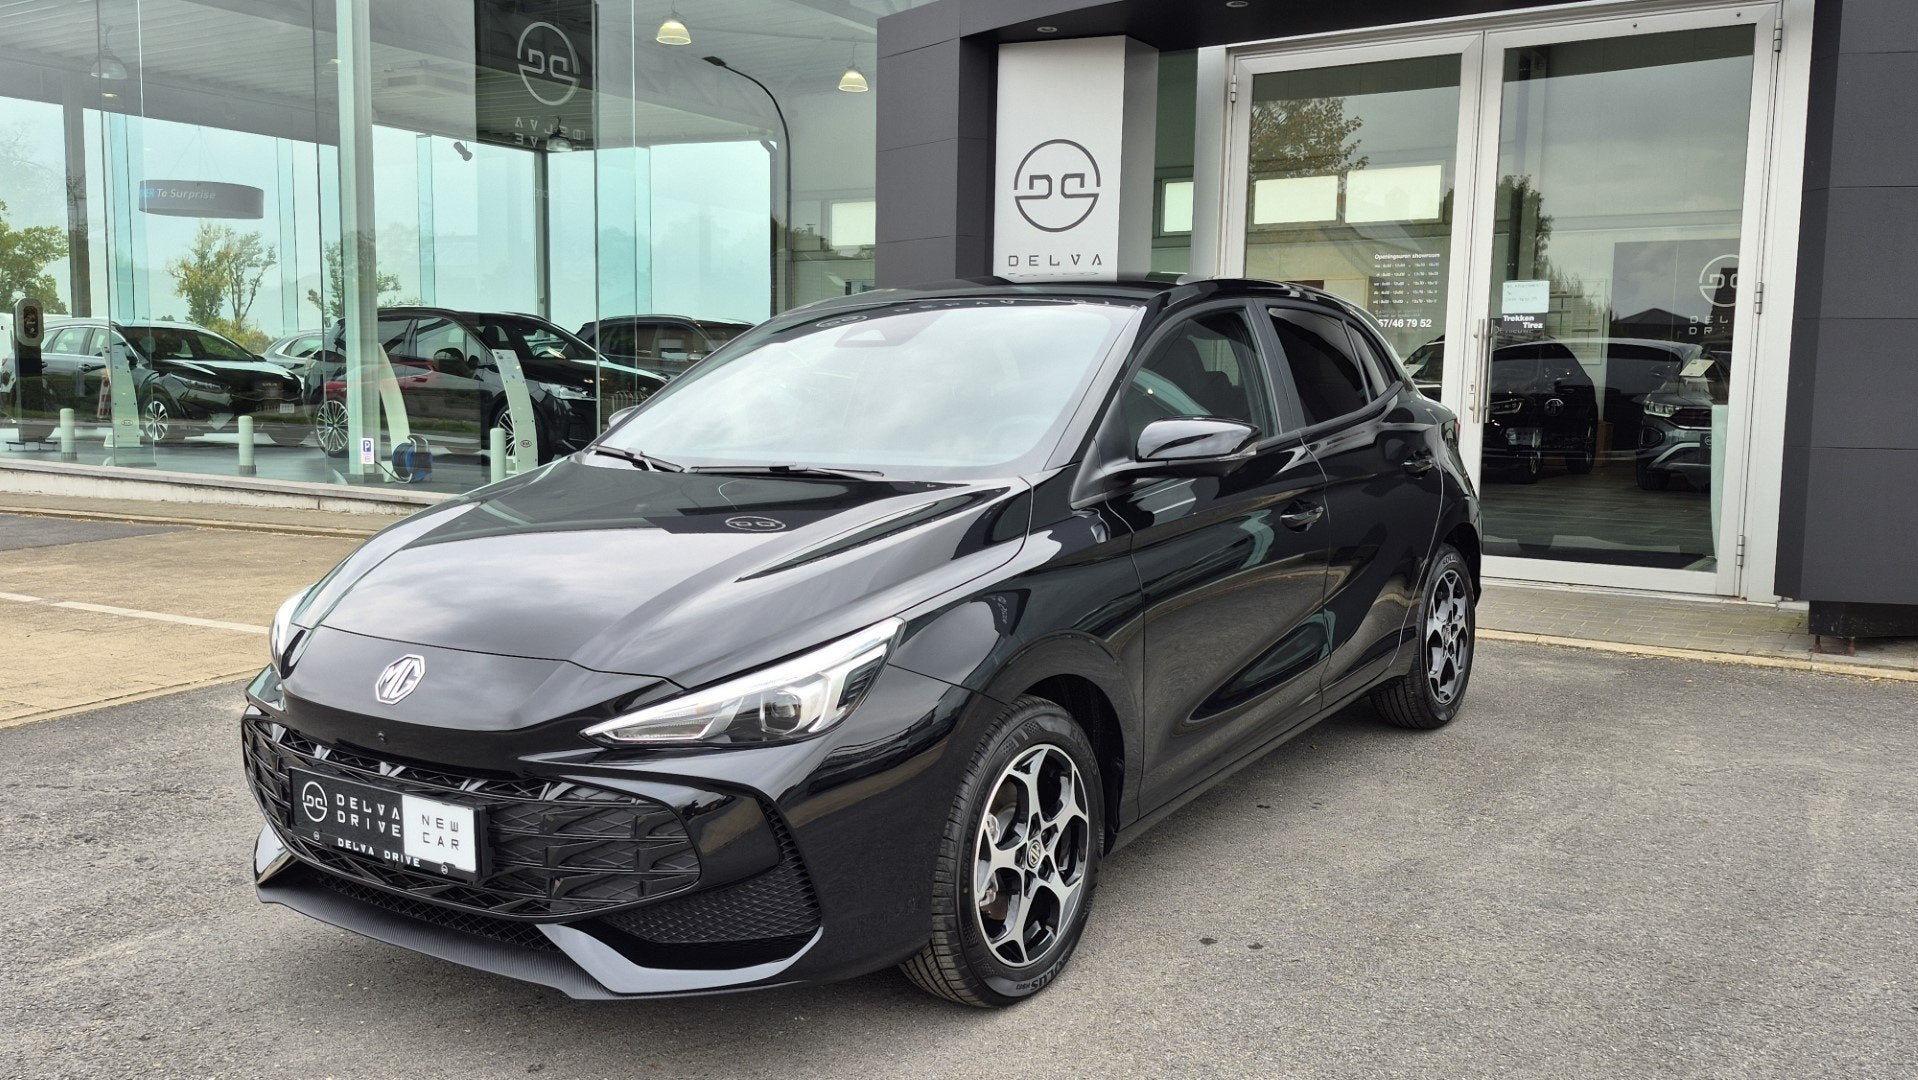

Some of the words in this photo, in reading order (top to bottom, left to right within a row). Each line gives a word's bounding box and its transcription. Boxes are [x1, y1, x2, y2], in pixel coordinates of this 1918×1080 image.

[156, 188, 168, 198] To
[170, 188, 217, 200] Surprise
[1008, 253, 1103, 267] DELVA
[1374, 253, 1411, 261] Openingsuren
[1406, 318, 1418, 328] 79
[1419, 318, 1432, 328] 52
[377, 656, 423, 702] MG
[336, 793, 401, 820] DELVA
[336, 810, 402, 838] DRIVE
[421, 814, 459, 833] NEW
[422, 831, 460, 851] CAR
[337, 837, 375, 856] DELVA
[384, 850, 421, 868] DRIVE
